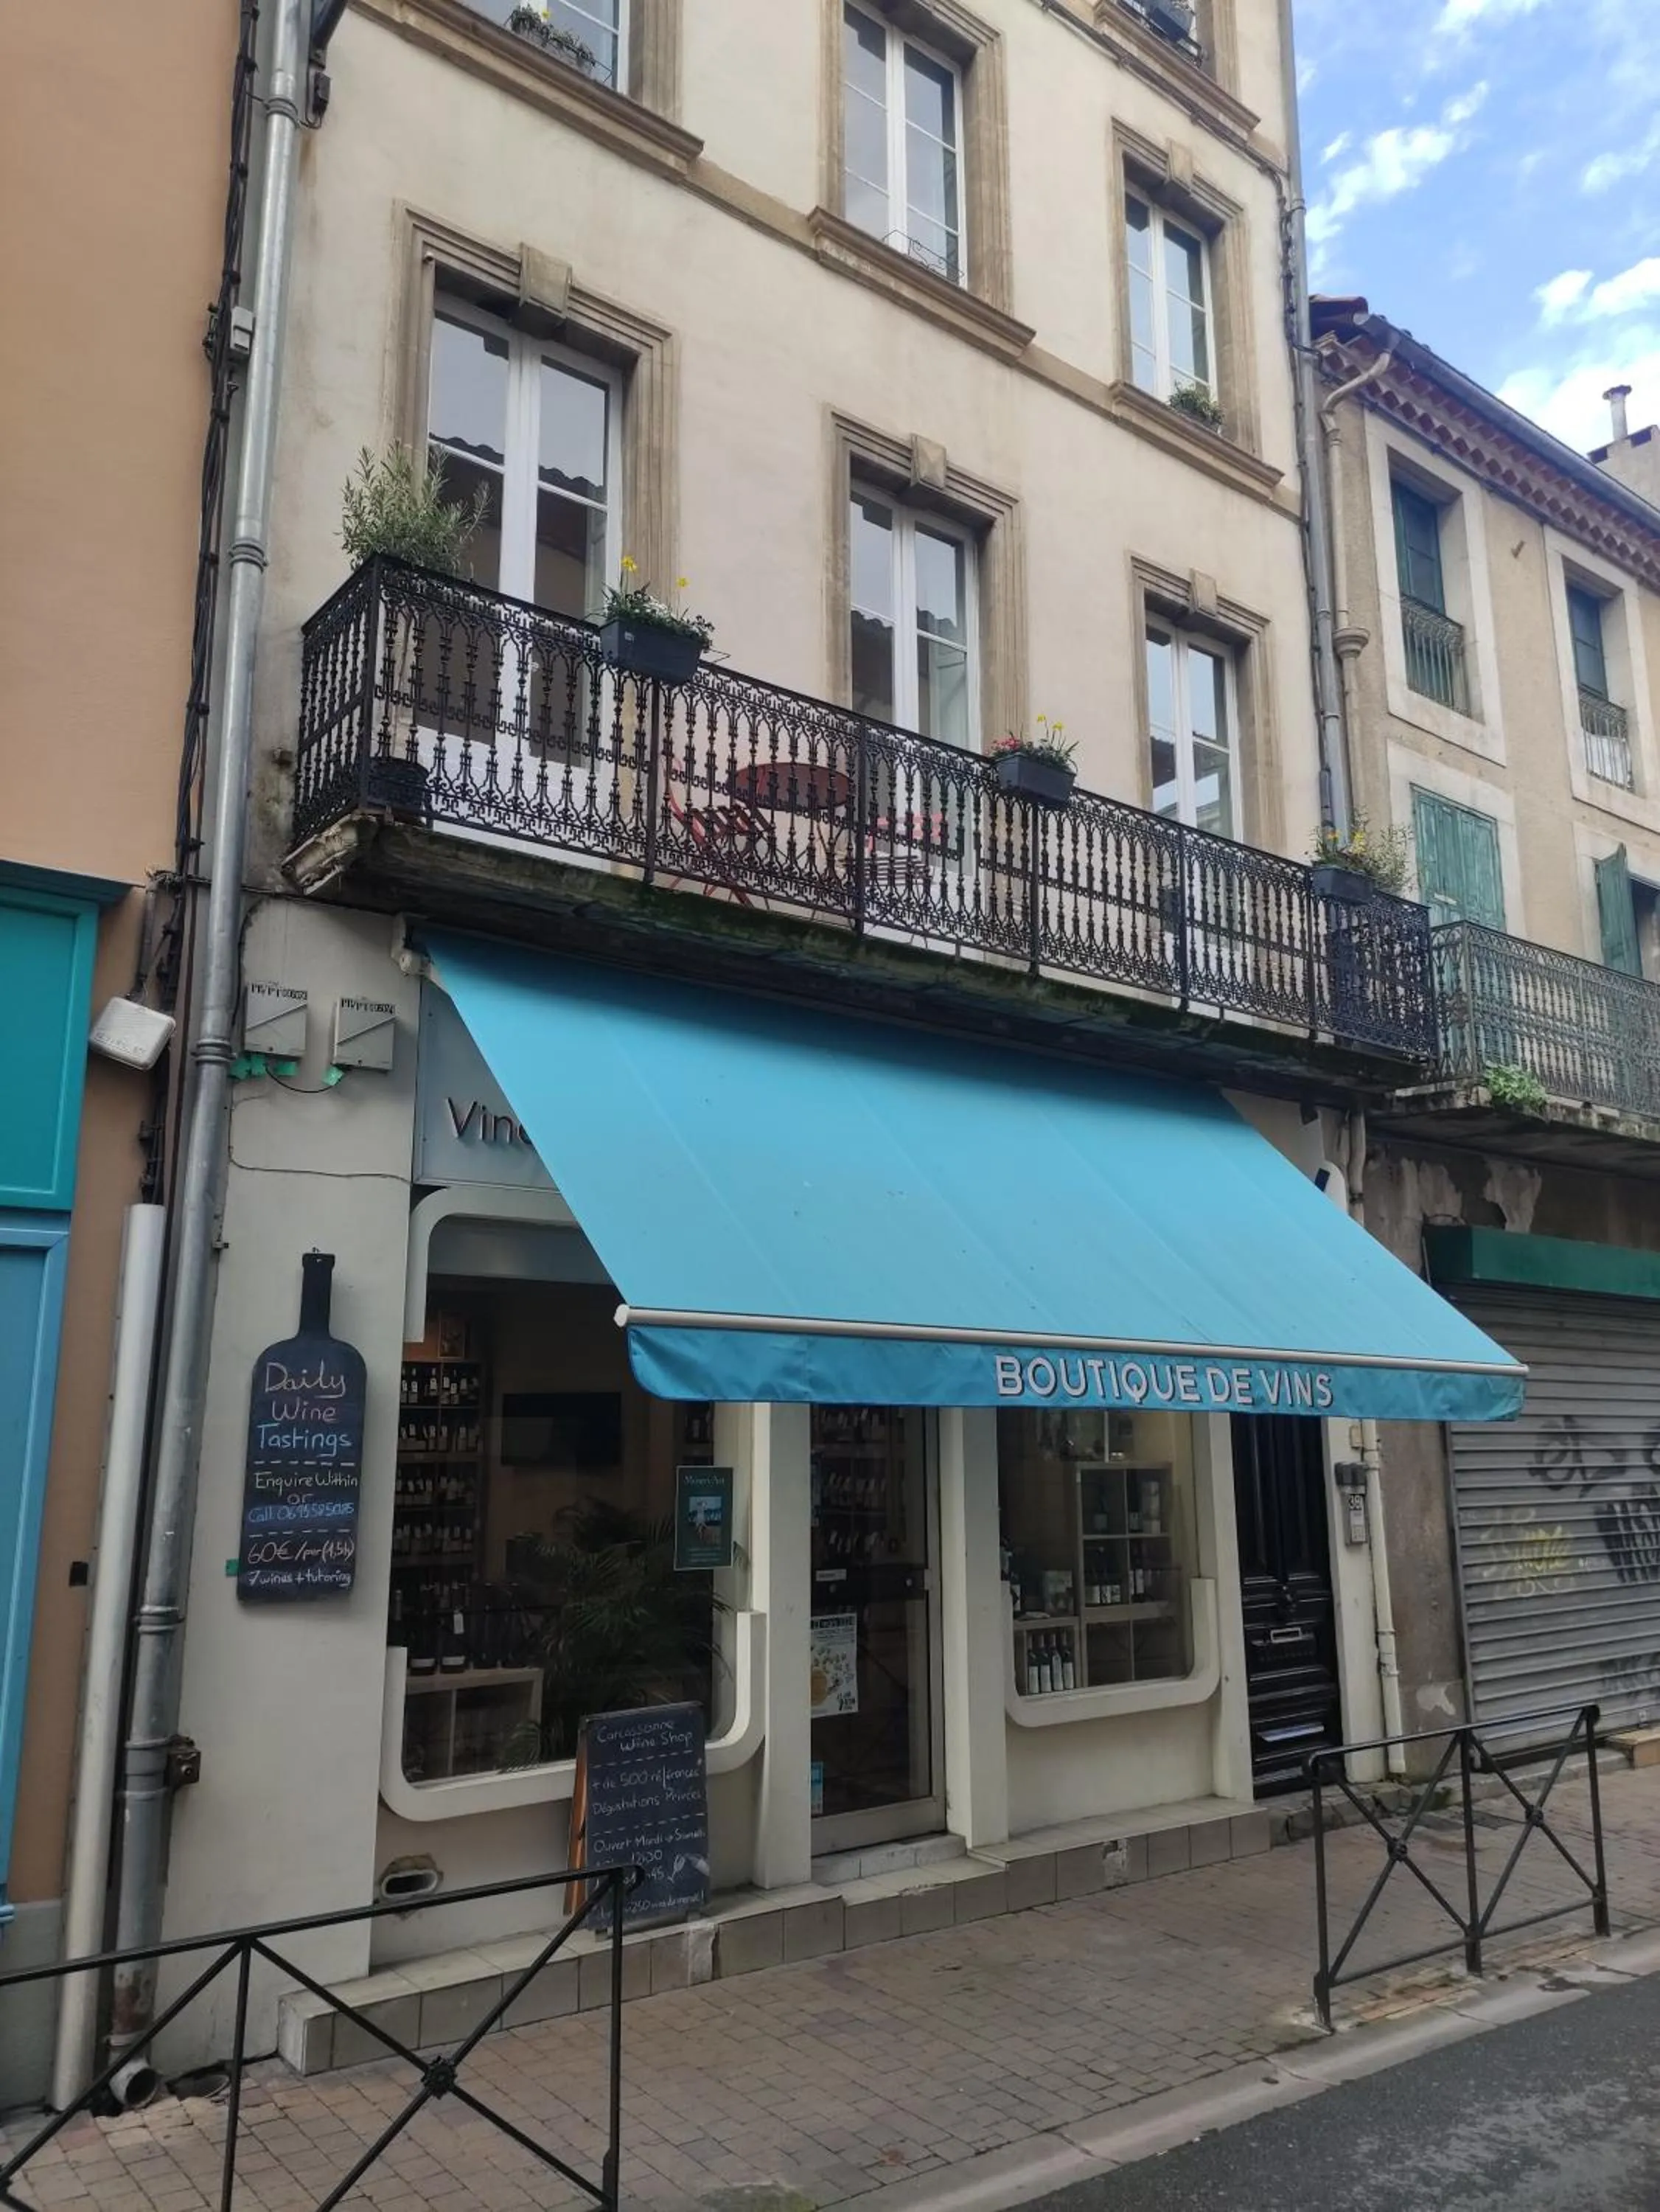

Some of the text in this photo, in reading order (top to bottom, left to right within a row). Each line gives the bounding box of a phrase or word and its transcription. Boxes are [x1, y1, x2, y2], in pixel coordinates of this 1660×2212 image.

[265, 1360, 346, 1399] Daily
[996, 1354, 1335, 1408] BOUTIQUE DE VINS
[272, 1397, 337, 1422] Wine
[257, 1423, 352, 1458] Tastings
[254, 1470, 358, 1497] Enquire Within
[287, 1493, 314, 1505] or
[597, 1721, 674, 1743] Carcassonne
[620, 1732, 692, 1751] Wine Shop
[620, 1771, 649, 1787] 500
